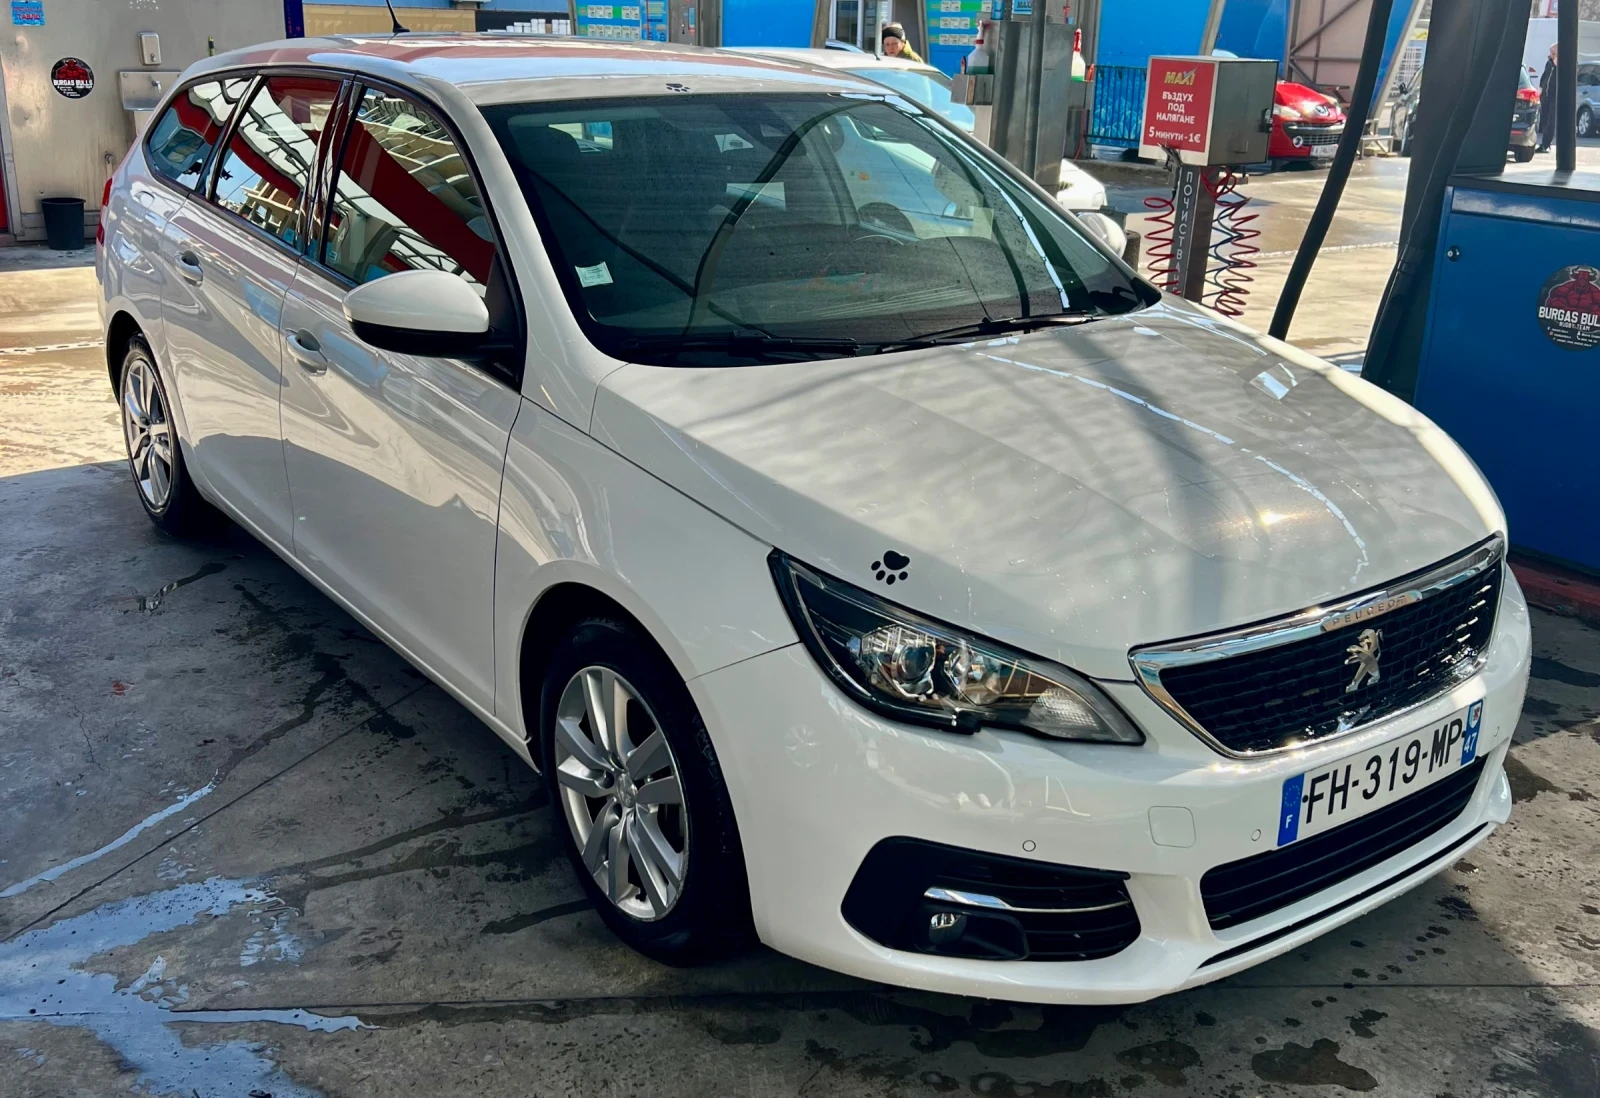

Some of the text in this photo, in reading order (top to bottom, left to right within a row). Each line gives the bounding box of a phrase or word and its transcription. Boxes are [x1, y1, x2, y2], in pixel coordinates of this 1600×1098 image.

[1164, 70, 1196, 86] MAXI
[1162, 91, 1193, 102] ВЪЗДУХ
[1167, 102, 1185, 113] ПОД
[1156, 112, 1195, 124] НАЛЯГАНЕ
[1149, 126, 1155, 138] 5
[1155, 130, 1183, 141] МИНУТИ
[1188, 132, 1201, 143] 1€
[1539, 306, 1578, 322] BURGAS
[1332, 596, 1406, 626] PEUGEOT
[1285, 718, 1477, 829] F FH-319-MP 47
